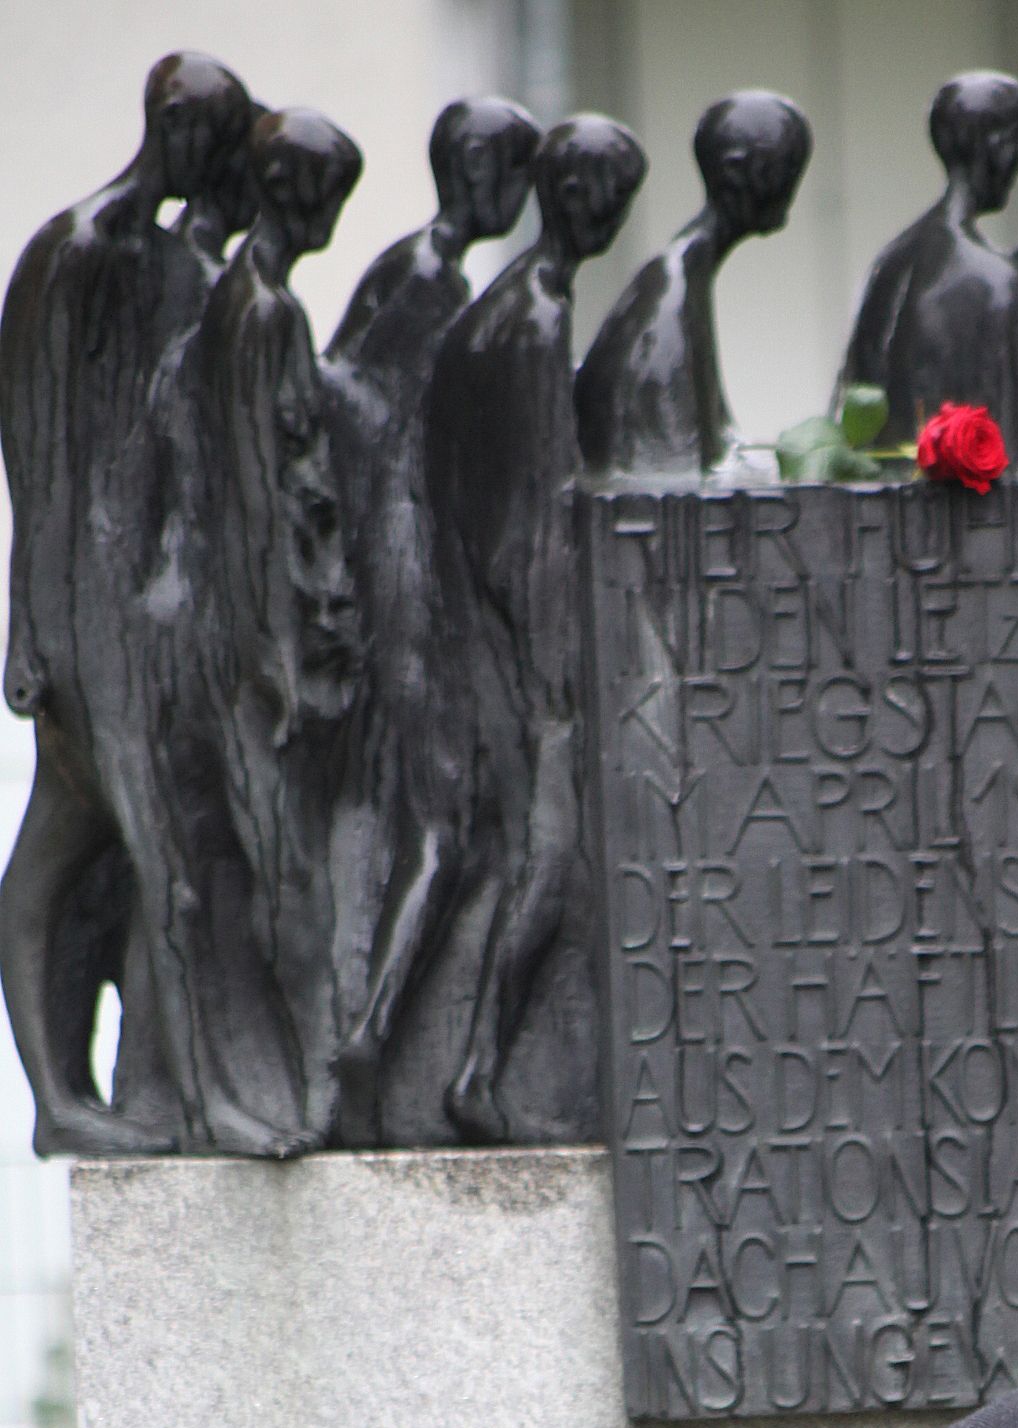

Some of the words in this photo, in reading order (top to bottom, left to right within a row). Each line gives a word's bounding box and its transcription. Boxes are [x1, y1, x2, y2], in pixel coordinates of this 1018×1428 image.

[610, 490, 808, 582] HIER
[700, 578, 858, 675] DEN
[620, 766, 708, 859] IM
[725, 755, 962, 858] APRIL
[617, 859, 757, 951] DER
[622, 952, 767, 1046] DER
[621, 1048, 757, 1140] AUS
[773, 1038, 906, 1136] DEM
[627, 1221, 938, 1325] DACHAU
[634, 1322, 747, 1418] INS
